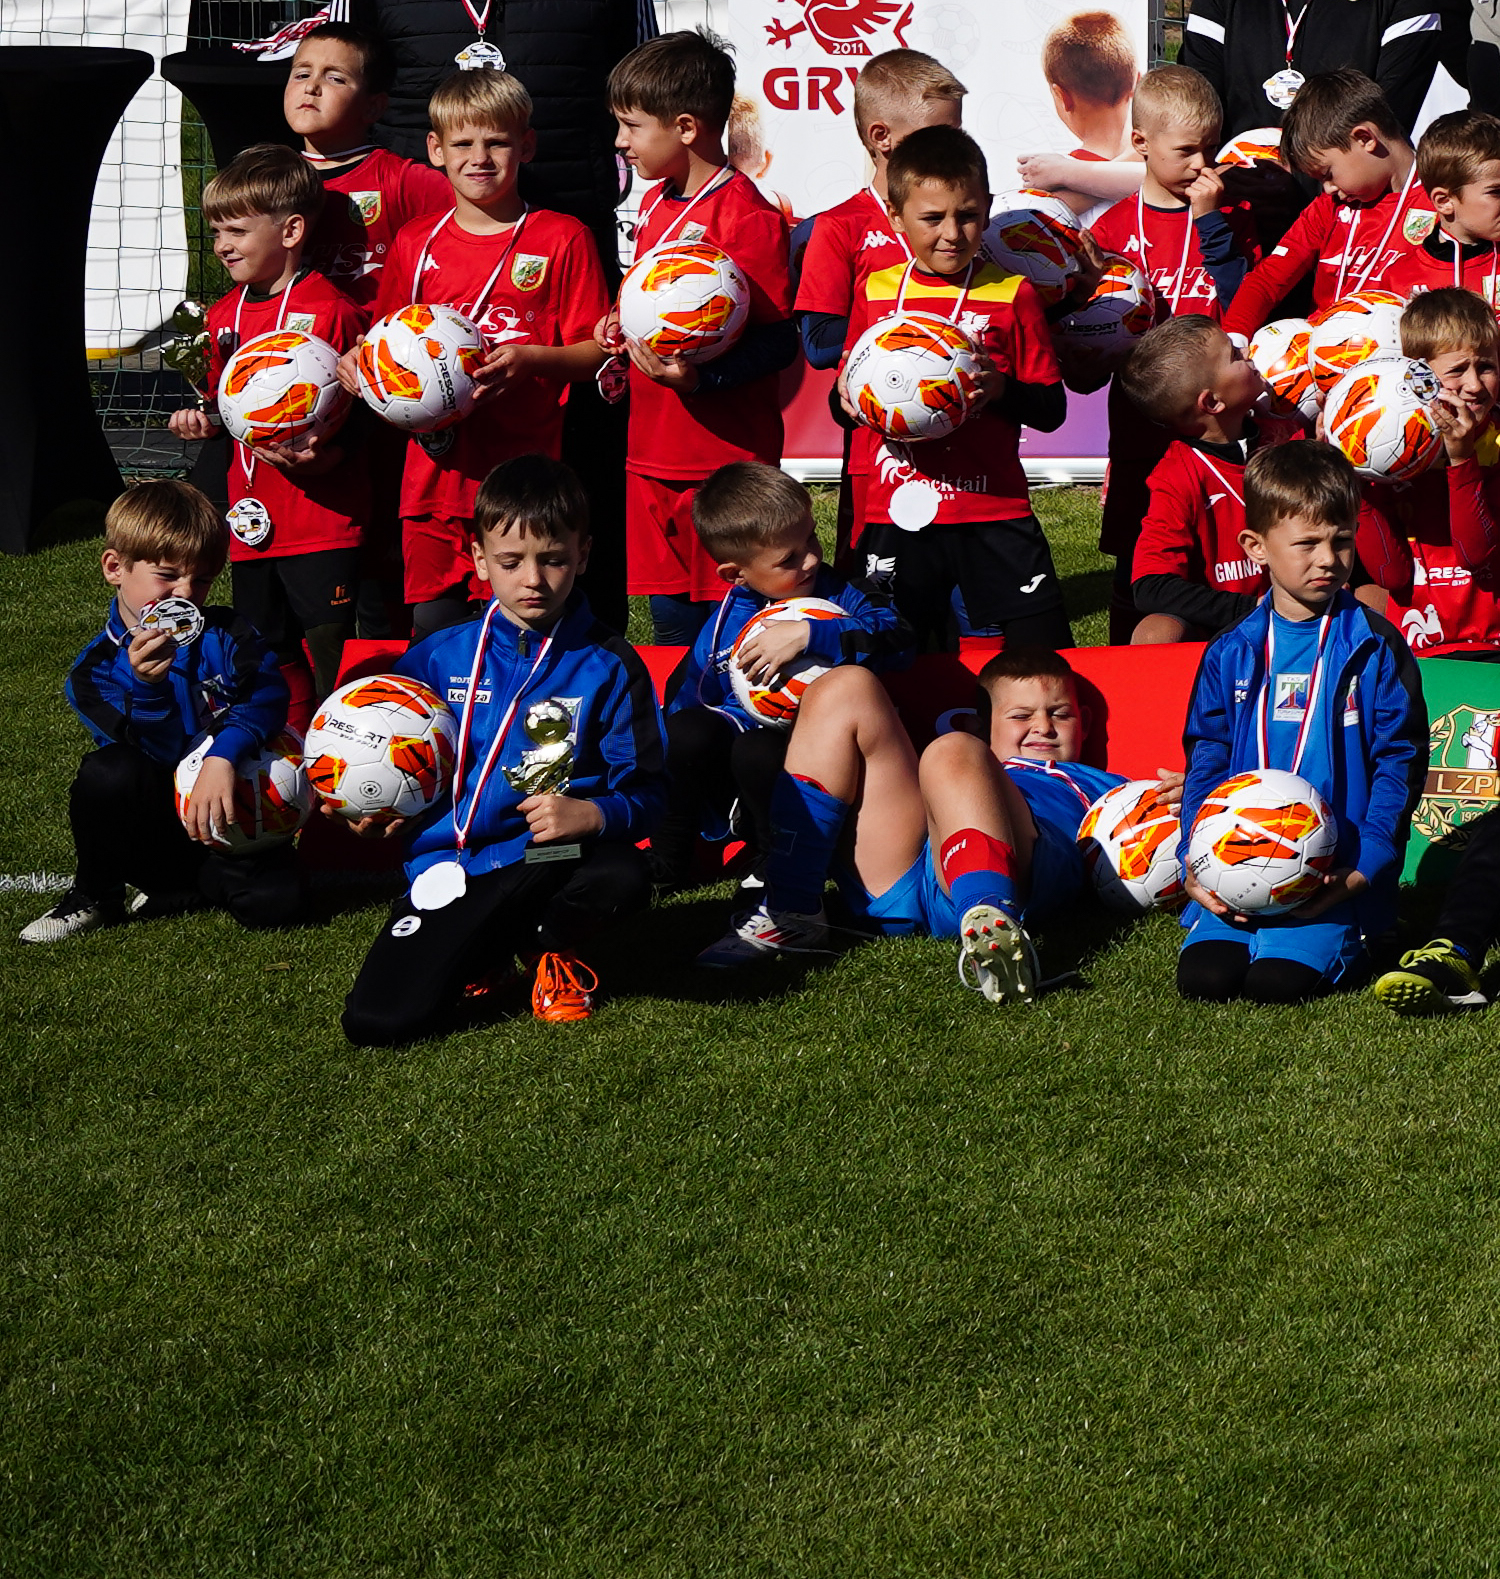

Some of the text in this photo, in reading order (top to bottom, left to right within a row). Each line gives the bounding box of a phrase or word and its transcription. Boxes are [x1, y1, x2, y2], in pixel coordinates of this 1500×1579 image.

[832, 42, 865, 55] 2011
[1068, 321, 1121, 334] RESORT
[439, 362, 457, 411] RESORT
[1214, 556, 1263, 585] GMINA
[449, 690, 488, 701] keza
[327, 713, 388, 747] RESORT
